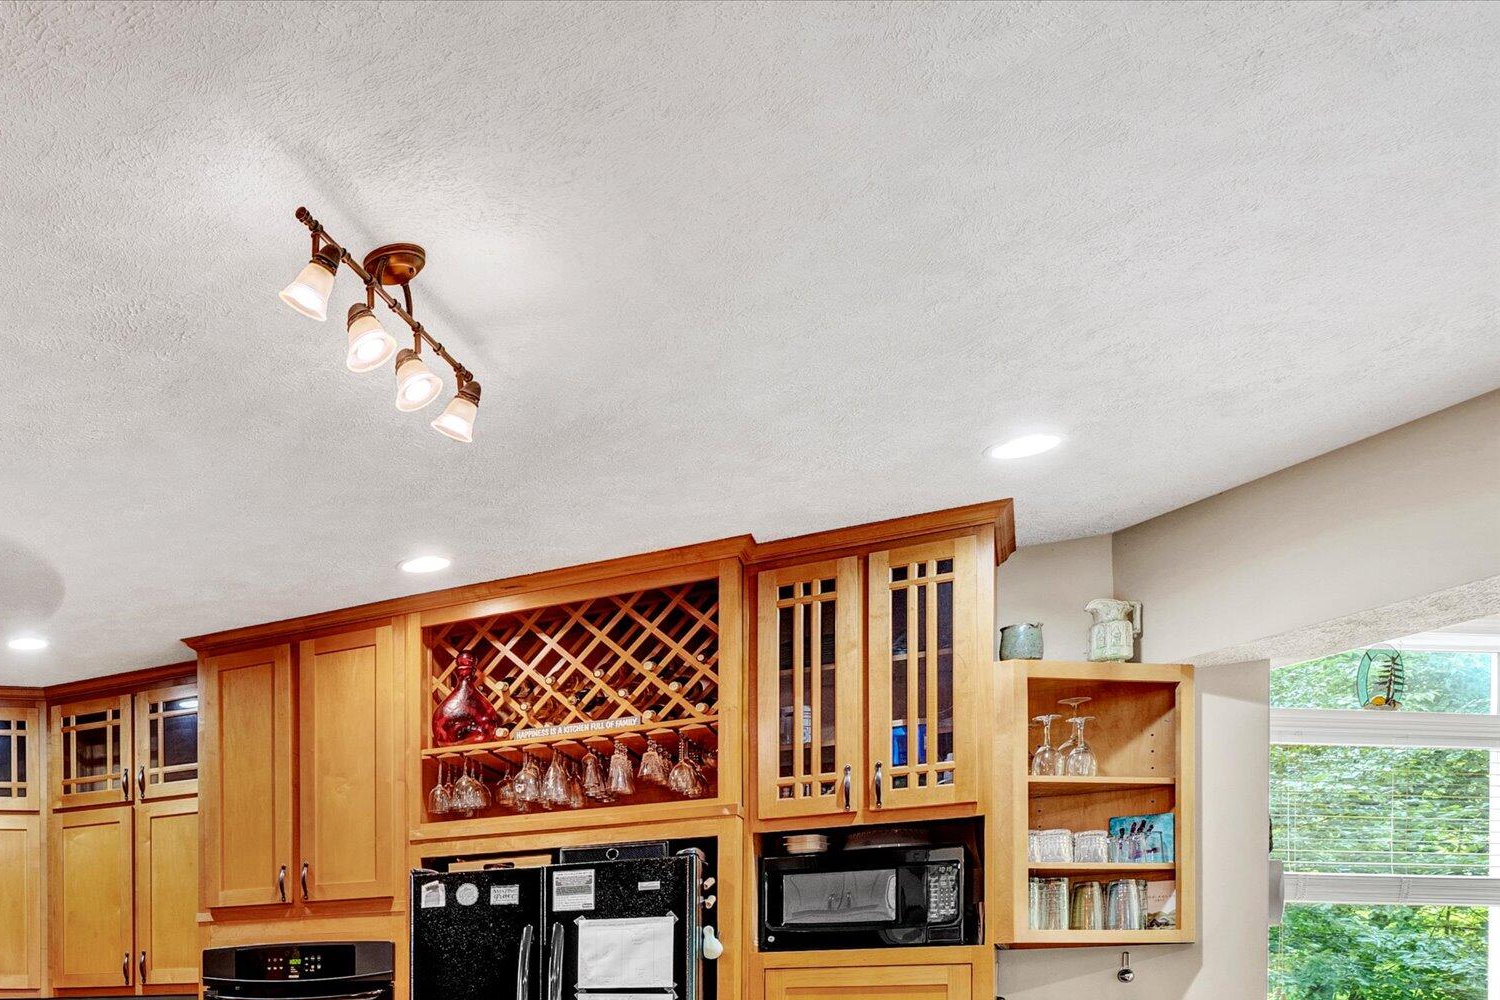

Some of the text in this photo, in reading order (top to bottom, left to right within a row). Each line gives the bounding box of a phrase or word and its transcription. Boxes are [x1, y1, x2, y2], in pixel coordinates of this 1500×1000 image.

[516, 728, 549, 740] HAPPINESS
[550, 726, 557, 735] IS
[563, 723, 590, 734] KITCHEN
[590, 721, 605, 731] FULL
[606, 719, 615, 730] OF
[615, 717, 638, 728] FAMILY
